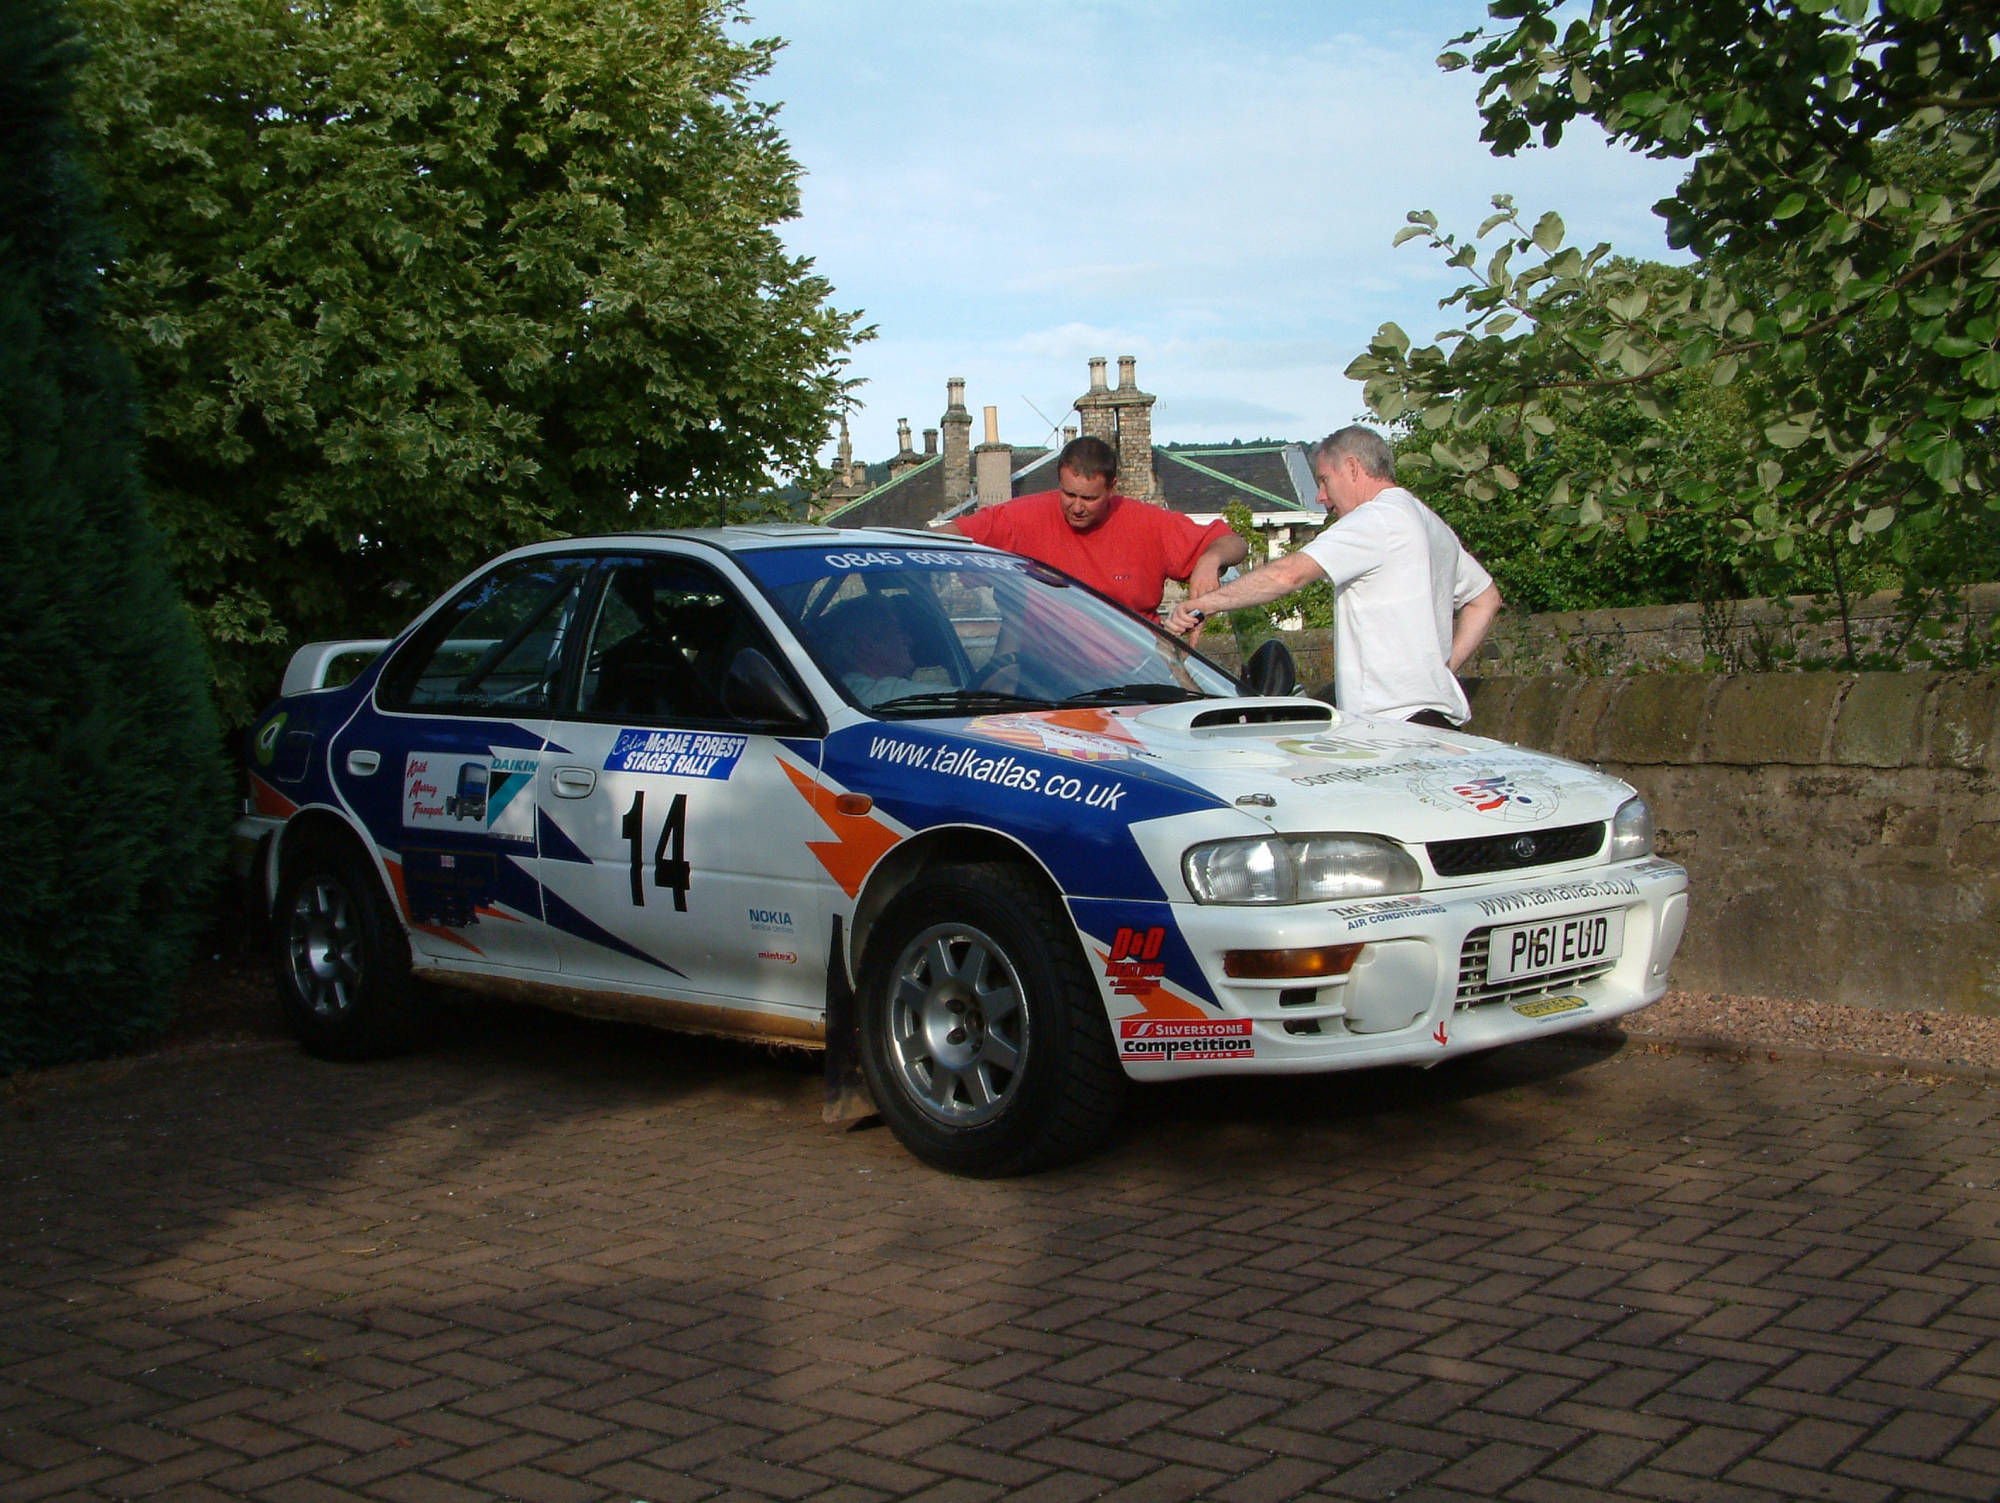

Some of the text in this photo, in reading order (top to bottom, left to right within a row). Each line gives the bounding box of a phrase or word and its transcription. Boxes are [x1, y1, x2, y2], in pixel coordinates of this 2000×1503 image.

[824, 552, 904, 569] 0845
[906, 551, 963, 567] 606
[643, 732, 693, 755] McRAE
[689, 735, 747, 759] FOREST
[491, 758, 539, 773] DAIKIN
[622, 751, 720, 776] STAGES RALLY
[868, 735, 1128, 811] www.talkatlas.co.uk
[621, 790, 691, 913] 14
[1475, 878, 1640, 917] www.talkatlas.co.uk
[749, 909, 793, 926] NOKIA
[1347, 905, 1448, 931] AIR CONDITIONING
[1561, 916, 1608, 963] EUD
[1155, 1023, 1243, 1036] SILVERSTONE
[1123, 1038, 1251, 1060] competition
